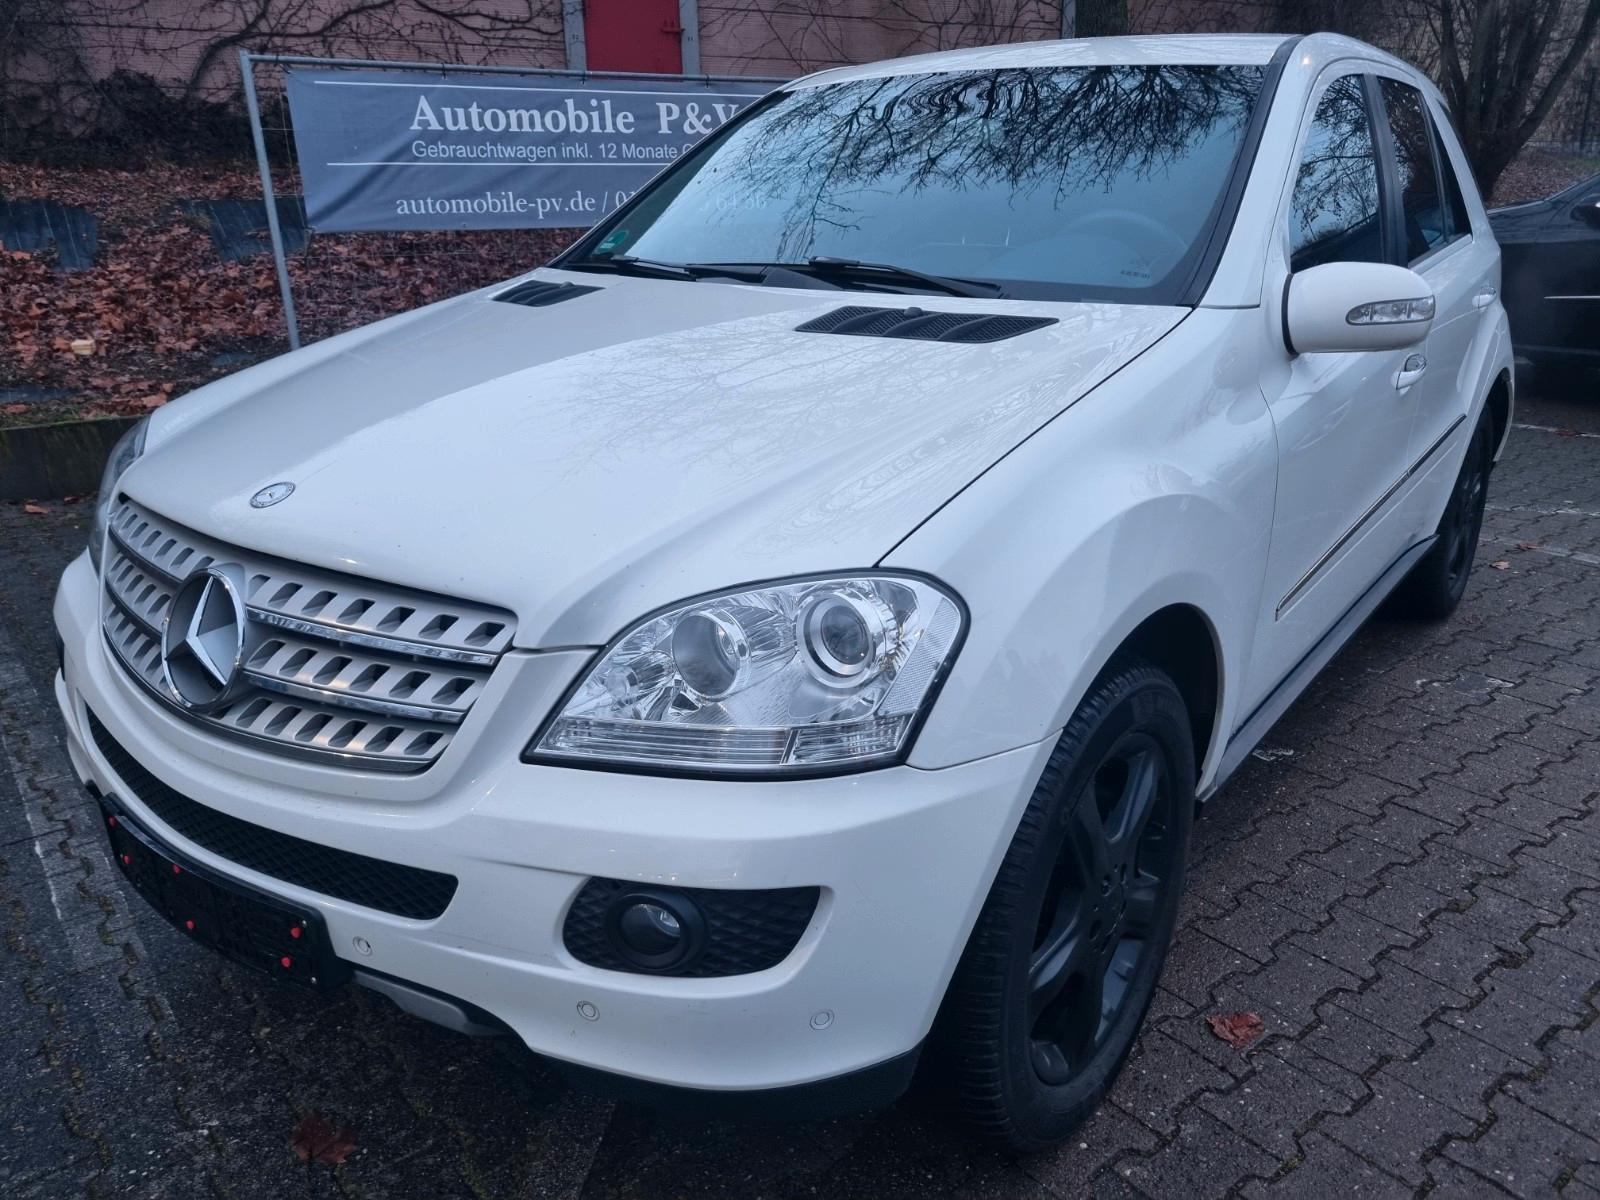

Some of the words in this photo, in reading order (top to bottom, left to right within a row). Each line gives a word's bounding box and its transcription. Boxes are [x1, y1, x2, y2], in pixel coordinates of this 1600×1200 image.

[409, 95, 635, 134] Automobile
[655, 102, 740, 134] P&V
[411, 140, 557, 162] Gebrauchtwagen
[561, 142, 593, 158] inkl.
[598, 143, 618, 159] 12
[622, 143, 678, 159] Monate
[395, 190, 596, 220] automobile-pv.de
